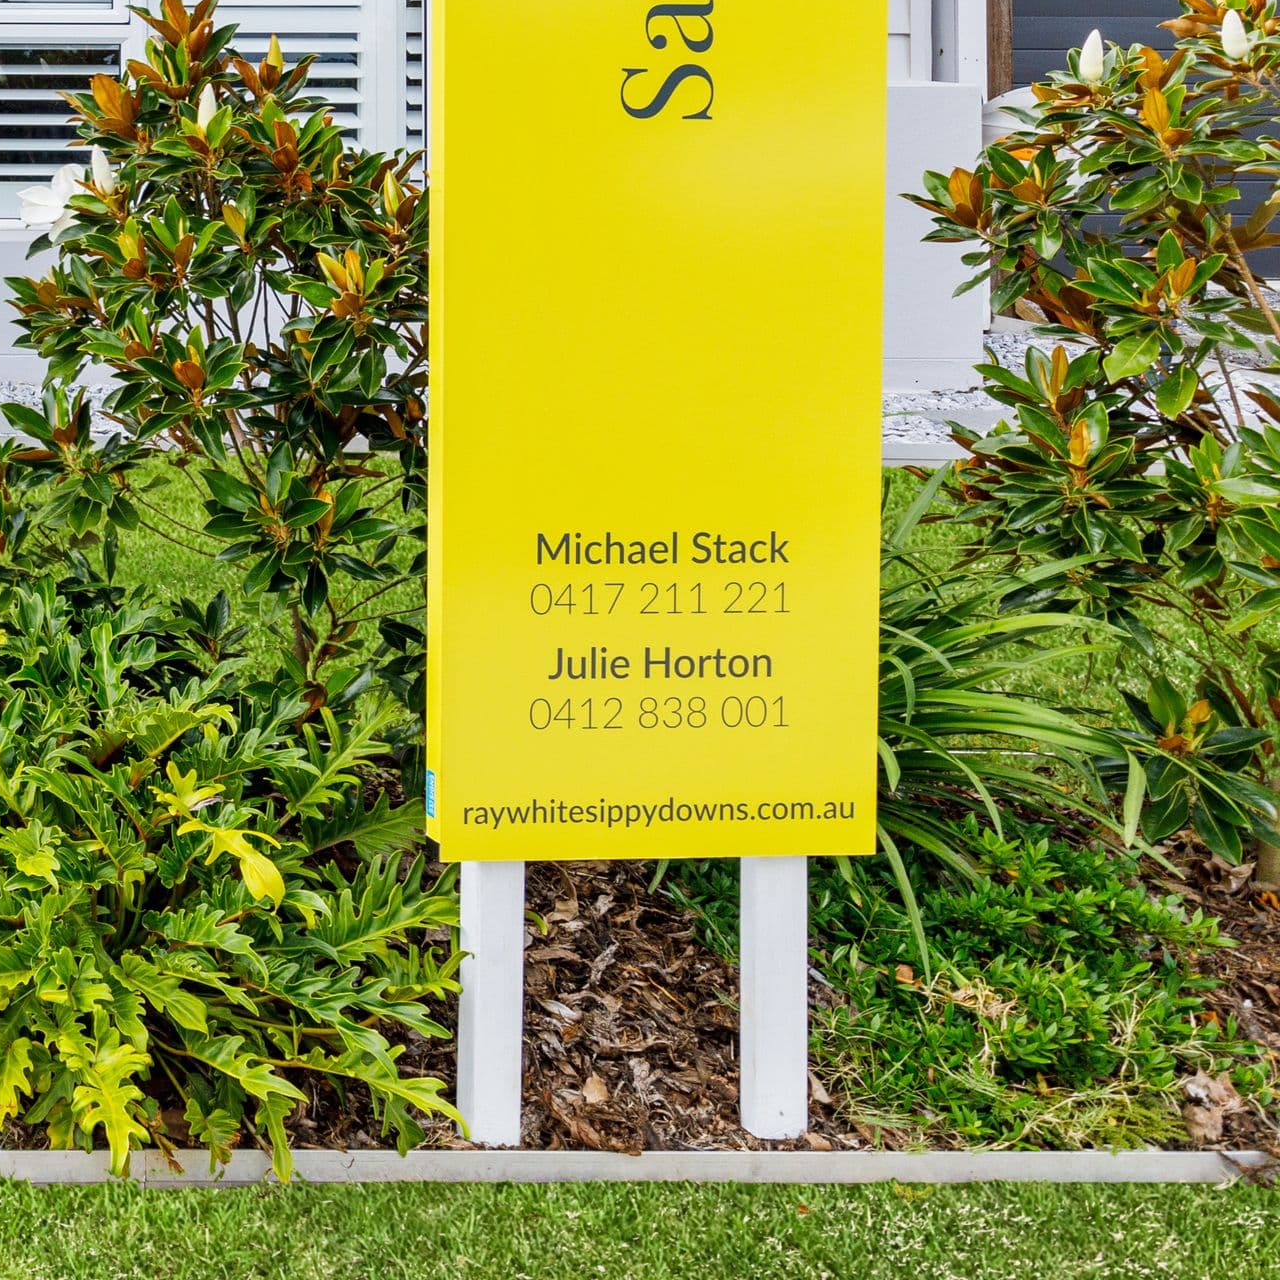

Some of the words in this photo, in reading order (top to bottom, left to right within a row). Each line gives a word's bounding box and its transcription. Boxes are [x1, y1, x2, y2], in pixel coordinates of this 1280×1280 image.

[537, 531, 678, 565] Michael
[691, 530, 790, 564] Stack
[530, 582, 625, 616] 0417
[639, 581, 708, 615] 211
[722, 581, 791, 614] 221
[548, 646, 630, 680] Julie
[644, 646, 772, 679] Horton
[529, 696, 624, 731] 0412
[638, 696, 708, 729] 838
[720, 695, 790, 728] 001
[463, 796, 855, 830] raywhitesippydowns.com.au
